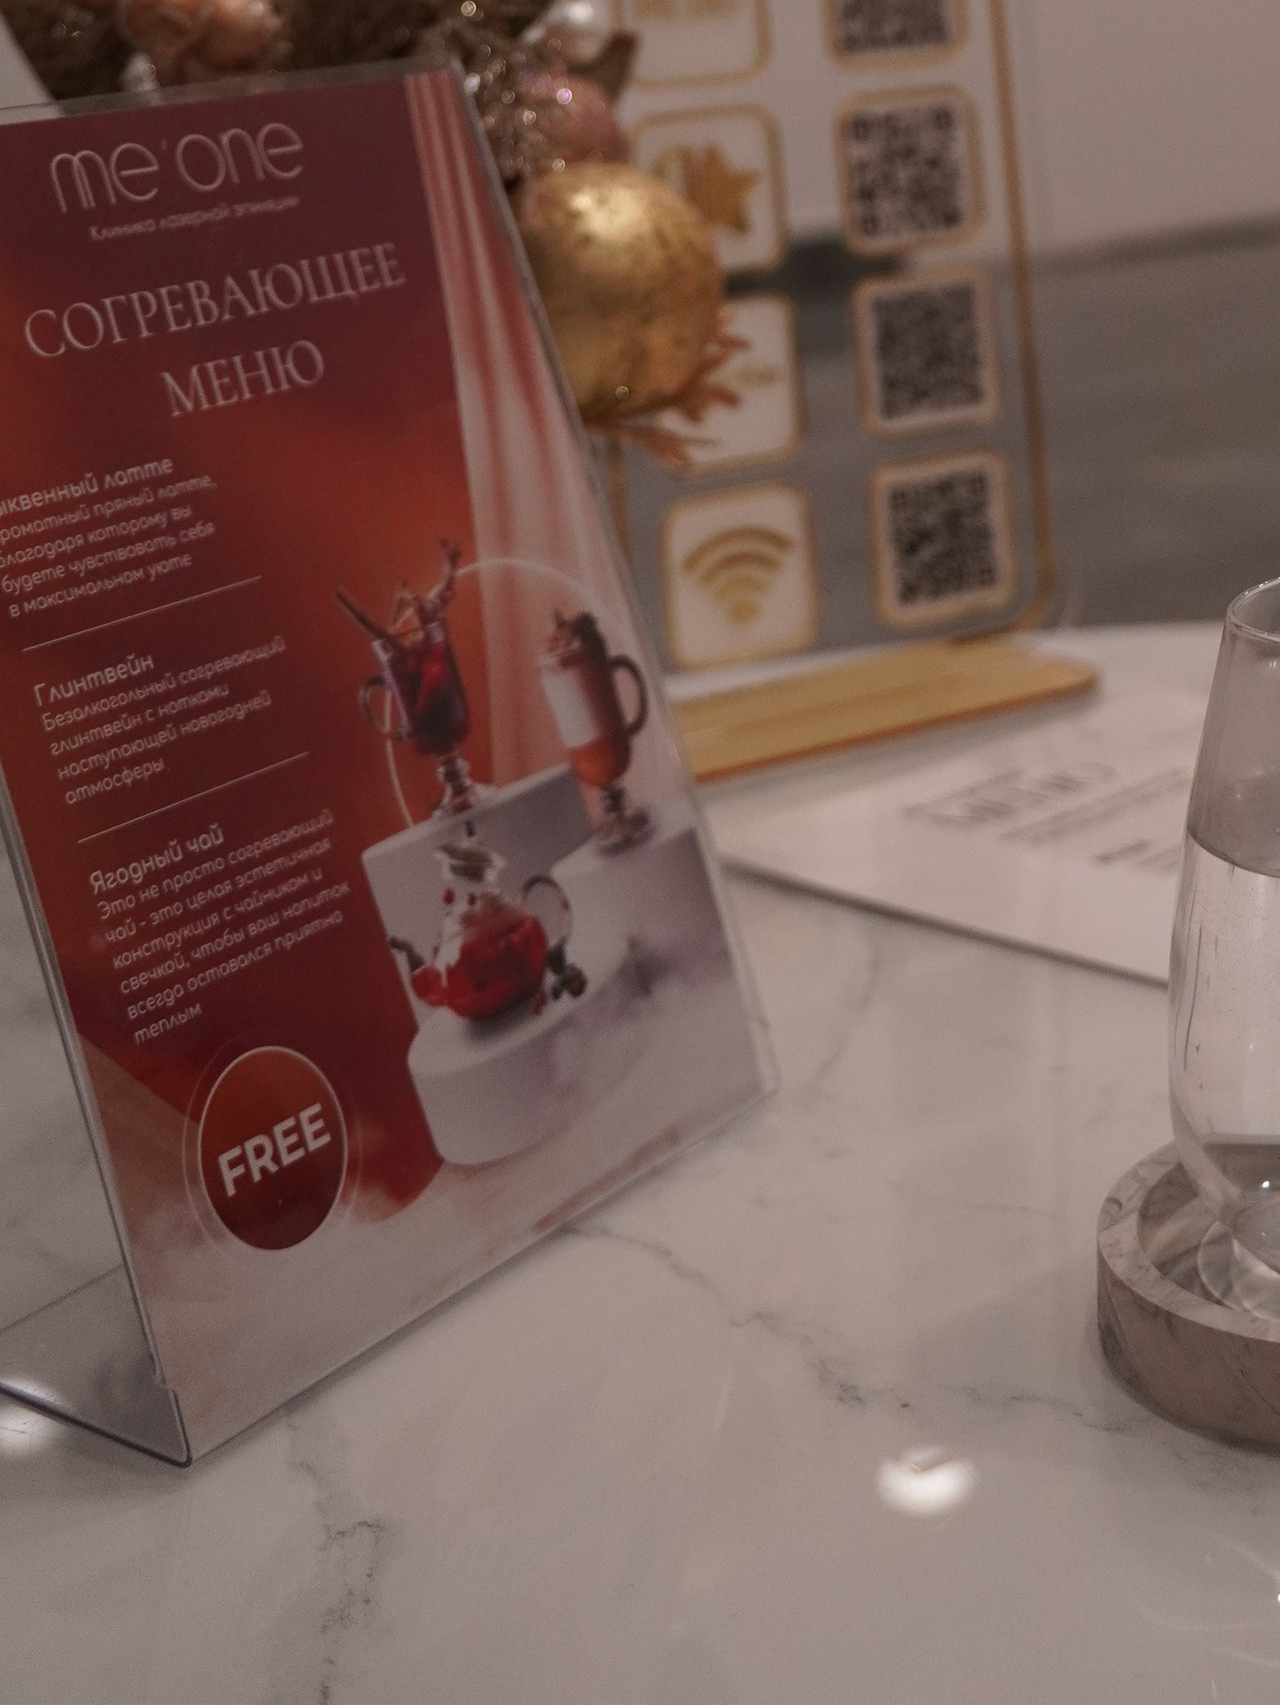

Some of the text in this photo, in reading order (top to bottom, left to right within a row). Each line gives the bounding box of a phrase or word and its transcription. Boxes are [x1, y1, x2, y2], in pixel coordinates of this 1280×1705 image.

[24, 243, 406, 357] СОГРЕВАЮЩЕЕ
[162, 339, 324, 417] МЕНЮ
[94, 488, 154, 517] пряный
[104, 458, 174, 489] латте
[2, 520, 216, 595] будете чувствовать себя
[88, 512, 167, 543] которому
[171, 505, 192, 521] вы
[9, 553, 192, 618] в максимальном уюте
[33, 653, 154, 706] Глинтвейн
[42, 635, 286, 731] Безалкогольный согревающий
[50, 683, 230, 755] глинтвейн с нотками
[57, 690, 272, 780] наступающей новогодней
[89, 822, 225, 895] Ягодный чай
[97, 807, 334, 919] Это не просто согревающий
[105, 918, 137, 943] чай
[150, 901, 184, 925] это
[186, 879, 233, 910] целая
[235, 837, 331, 888] эстетичная
[113, 867, 324, 970] конструкция с чайником и
[120, 881, 349, 994] свечкой, чтобы ваш напиток
[127, 910, 343, 1020] всегда оставался приятно
[134, 1003, 202, 1045] теплым
[218, 1102, 331, 1198] FREE
